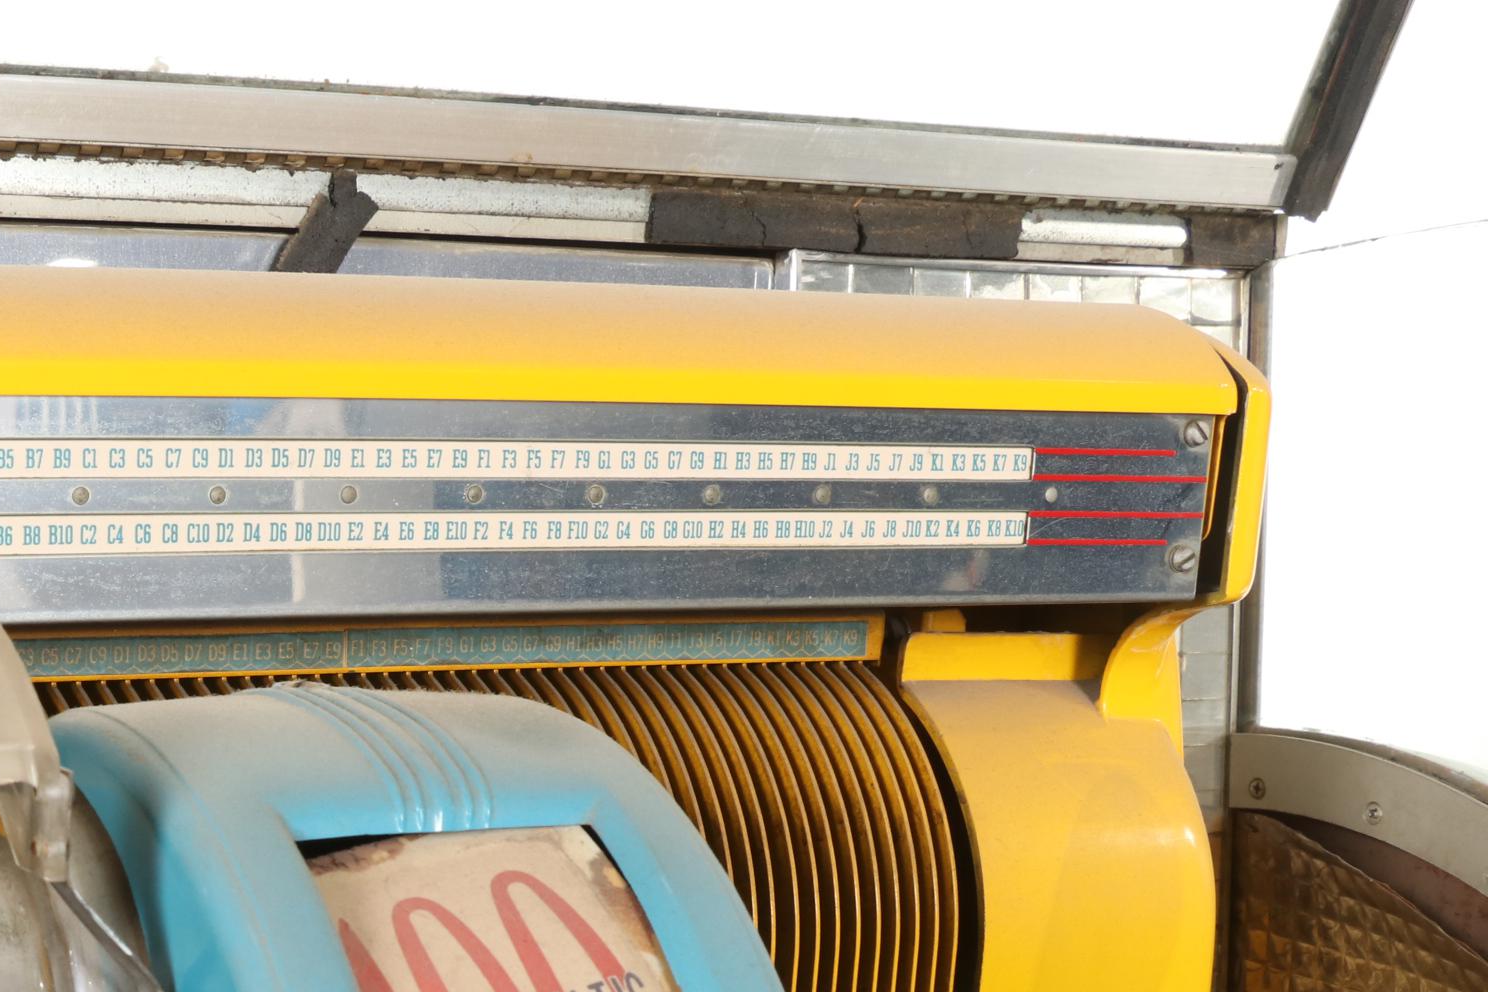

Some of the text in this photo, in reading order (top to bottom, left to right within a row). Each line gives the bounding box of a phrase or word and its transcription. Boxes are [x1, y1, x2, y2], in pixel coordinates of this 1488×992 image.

[26, 448, 44, 470] B7
[53, 448, 72, 470] B9
[82, 447, 98, 470] C1
[109, 448, 126, 469] C3
[136, 447, 154, 469] C5
[165, 448, 183, 469] C7
[192, 447, 209, 469] C9
[218, 448, 235, 469] D1
[245, 448, 264, 469] D3
[271, 447, 290, 469] D5
[297, 448, 316, 469] D7
[323, 448, 342, 469] D9
[351, 448, 366, 469] E1
[375, 448, 393, 469] E3
[401, 448, 418, 469] E5
[426, 448, 443, 469] E7
[452, 448, 469, 469] E9
[477, 448, 491, 469] F1
[501, 449, 518, 469] F3
[526, 449, 542, 470] F5
[550, 449, 566, 470] F7
[575, 450, 591, 470] F9
[598, 450, 612, 470] G1
[621, 450, 637, 470] G3
[644, 450, 659, 471] G5
[667, 450, 683, 471] G7
[690, 450, 705, 471] G9
[713, 451, 728, 471] H1
[735, 451, 752, 471] H3
[757, 451, 774, 471] H5
[780, 451, 797, 471] H7
[801, 452, 818, 471] H9
[823, 452, 838, 472] J1
[844, 452, 860, 472] J3
[866, 453, 881, 472] J5
[888, 453, 904, 472] J7
[909, 453, 924, 472] J9
[930, 453, 945, 472] K1
[951, 453, 967, 472] K3
[971, 453, 987, 473] K5
[992, 453, 1008, 472] K7
[1012, 454, 1028, 473] K9
[23, 525, 42, 546] B8
[48, 524, 74, 546] B10
[80, 524, 98, 546] C2
[107, 524, 125, 545] C4
[134, 523, 152, 545] C6
[162, 523, 179, 545] C8
[187, 523, 211, 544] C10
[216, 522, 235, 544] D2
[243, 522, 262, 543] D4
[269, 522, 288, 543] D6
[294, 522, 313, 543] D8
[317, 522, 342, 542] D10
[347, 521, 365, 542] E2
[373, 521, 390, 542] E4
[398, 521, 415, 542] E6
[423, 521, 440, 541] E8
[445, 520, 468, 541] E10
[473, 520, 489, 541] F2
[498, 520, 514, 541] F4
[522, 520, 538, 541] F6
[546, 520, 563, 541] F8
[567, 520, 589, 541] F10
[593, 520, 610, 541] G2
[616, 520, 632, 541] G4
[640, 520, 656, 540] G6
[663, 520, 679, 540] G8
[682, 520, 704, 540] G10
[708, 520, 725, 540] H2
[730, 520, 747, 539] H4
[752, 520, 769, 539] H6
[775, 520, 792, 539] H8
[794, 520, 816, 540] H10
[817, 520, 834, 539] J2
[840, 520, 854, 539] J4
[861, 520, 876, 539] J6
[882, 520, 898, 539] J8
[902, 519, 923, 539] J10
[924, 519, 941, 539] K2
[945, 519, 961, 538] K4
[966, 519, 982, 538] K6
[986, 519, 1002, 539] K8
[1004, 519, 1024, 539] K10
[41, 647, 60, 666] C5
[64, 646, 83, 665] C7
[88, 645, 108, 665] C9
[112, 645, 131, 664] D1
[137, 644, 157, 663] D3
[159, 643, 180, 663] D5
[183, 642, 203, 663] D7
[207, 642, 227, 662] D9
[232, 642, 249, 662] E1
[254, 641, 273, 661] E3
[277, 641, 295, 660] E5
[302, 640, 320, 660] E7
[324, 640, 342, 660] E9
[350, 639, 365, 658] F1
[371, 638, 388, 658] F3
[392, 638, 409, 657] F5
[414, 637, 432, 656] F7
[436, 635, 454, 655] F9
[458, 634, 475, 654] G1
[479, 634, 497, 653] G3
[501, 634, 519, 653] G5
[522, 634, 540, 653] G7
[544, 634, 562, 653] G9
